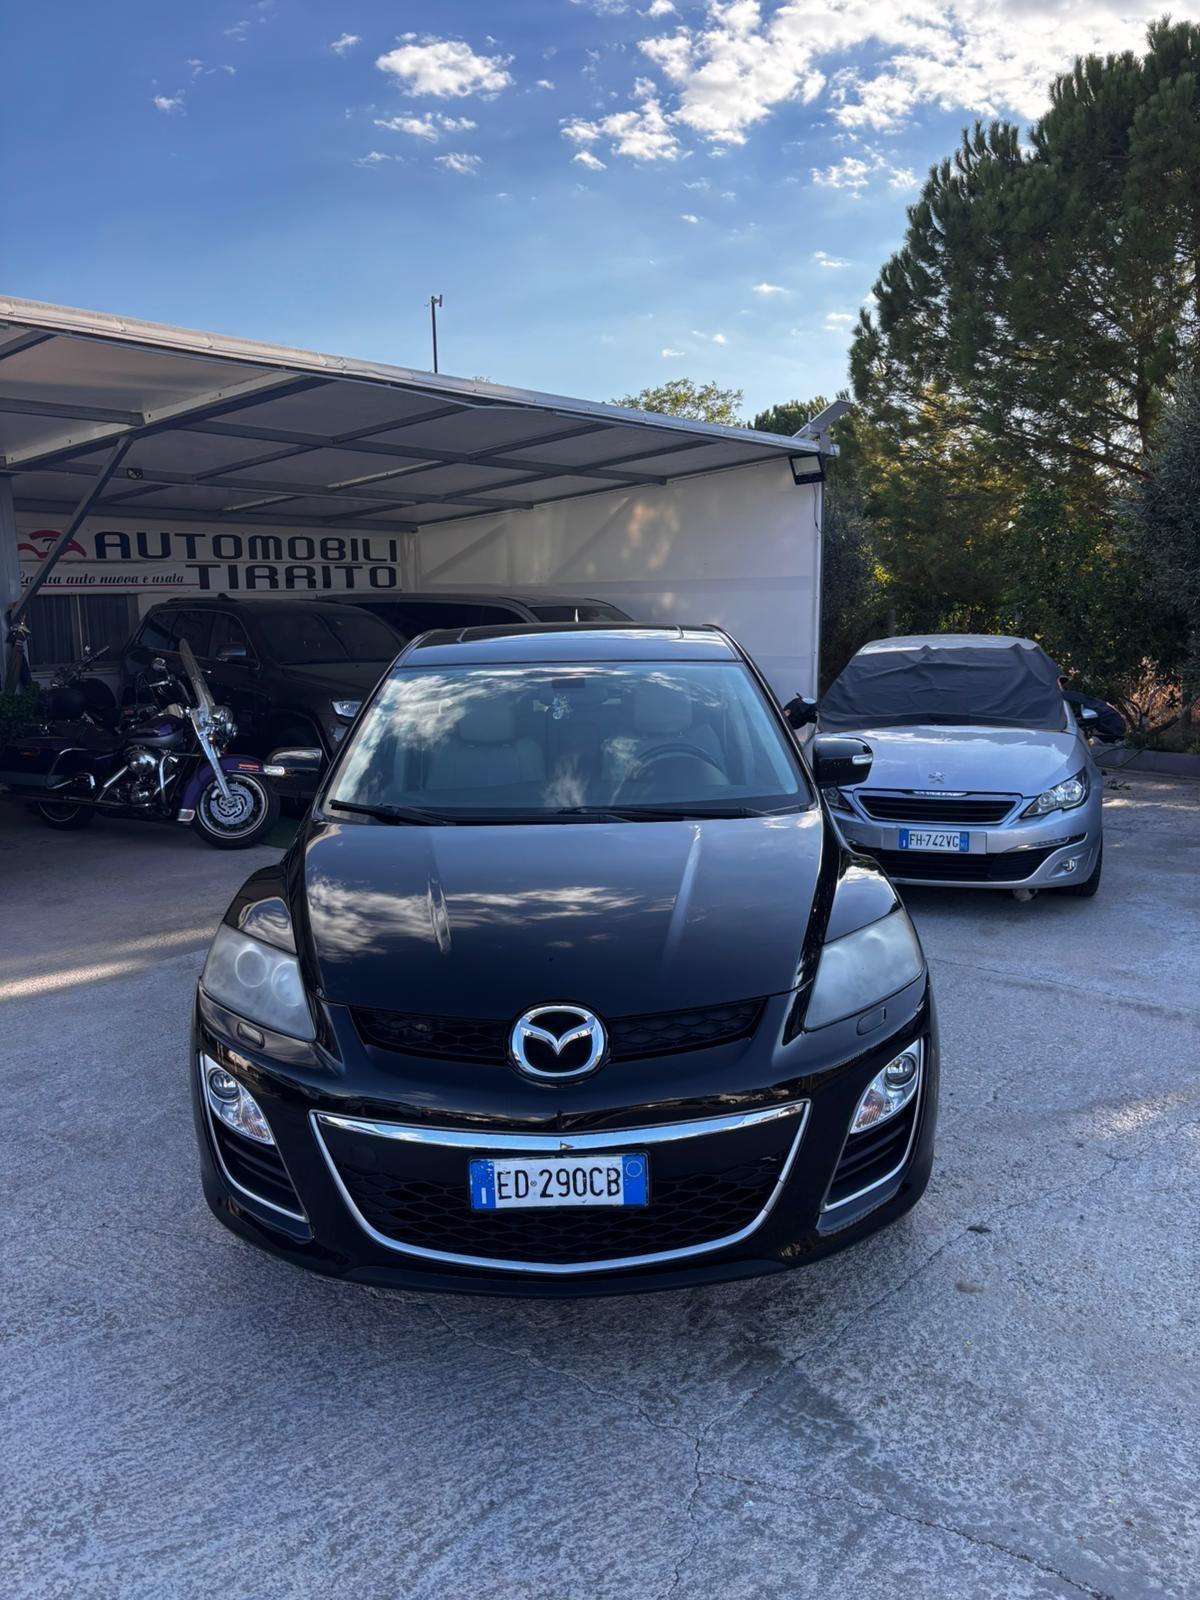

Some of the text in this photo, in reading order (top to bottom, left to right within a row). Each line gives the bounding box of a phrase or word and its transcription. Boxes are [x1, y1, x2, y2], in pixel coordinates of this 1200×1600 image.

[94, 531, 397, 562] AUTOMOBILI
[66, 573, 96, 584] auto
[100, 575, 138, 584] nuova
[142, 576, 148, 584] e
[152, 573, 184, 583] usata
[185, 564, 397, 590] TIRRITO
